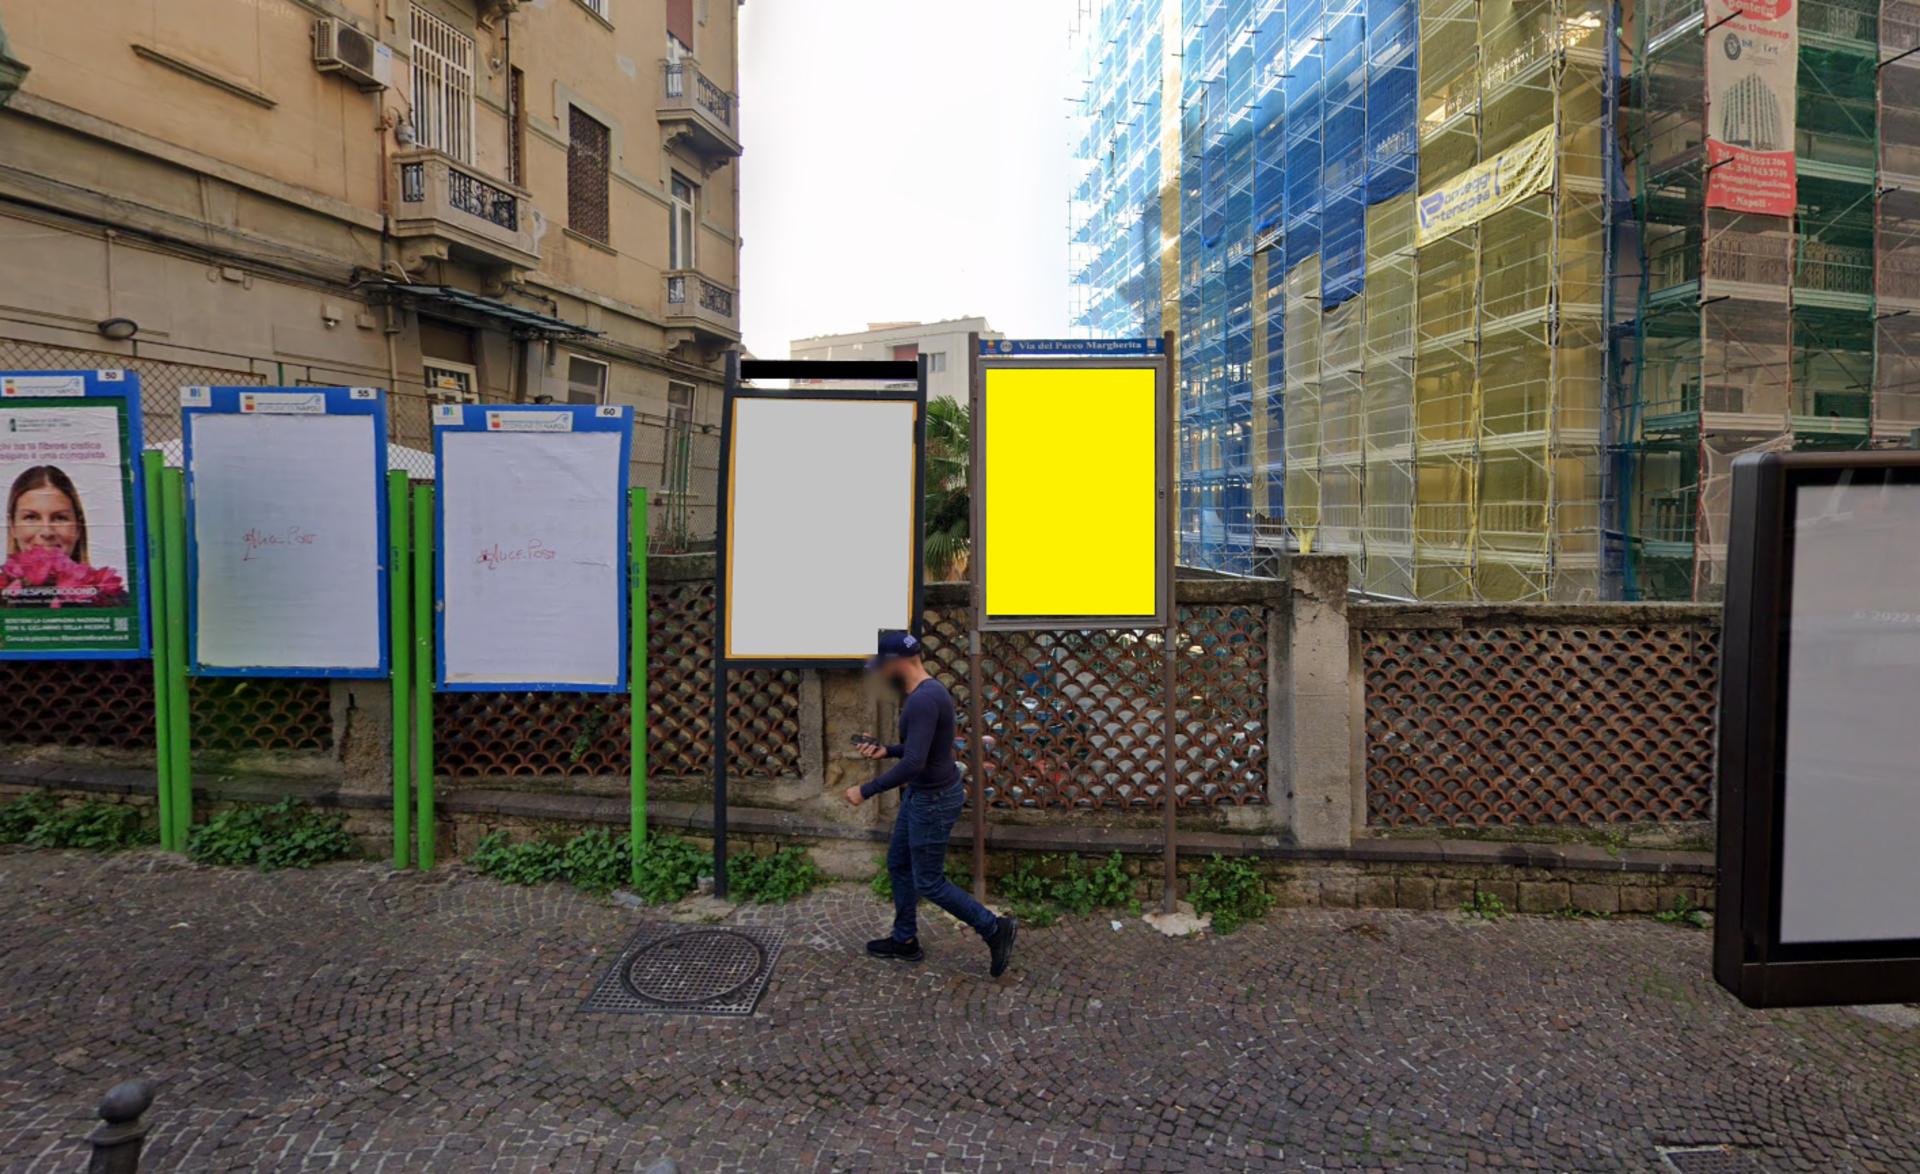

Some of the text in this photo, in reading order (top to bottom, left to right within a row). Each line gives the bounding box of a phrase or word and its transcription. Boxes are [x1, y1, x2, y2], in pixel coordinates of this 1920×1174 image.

[1018, 340, 1142, 352] Via del Parco Margherita
[105, 371, 117, 380] 50
[357, 389, 370, 398] 55
[603, 407, 616, 416] 60
